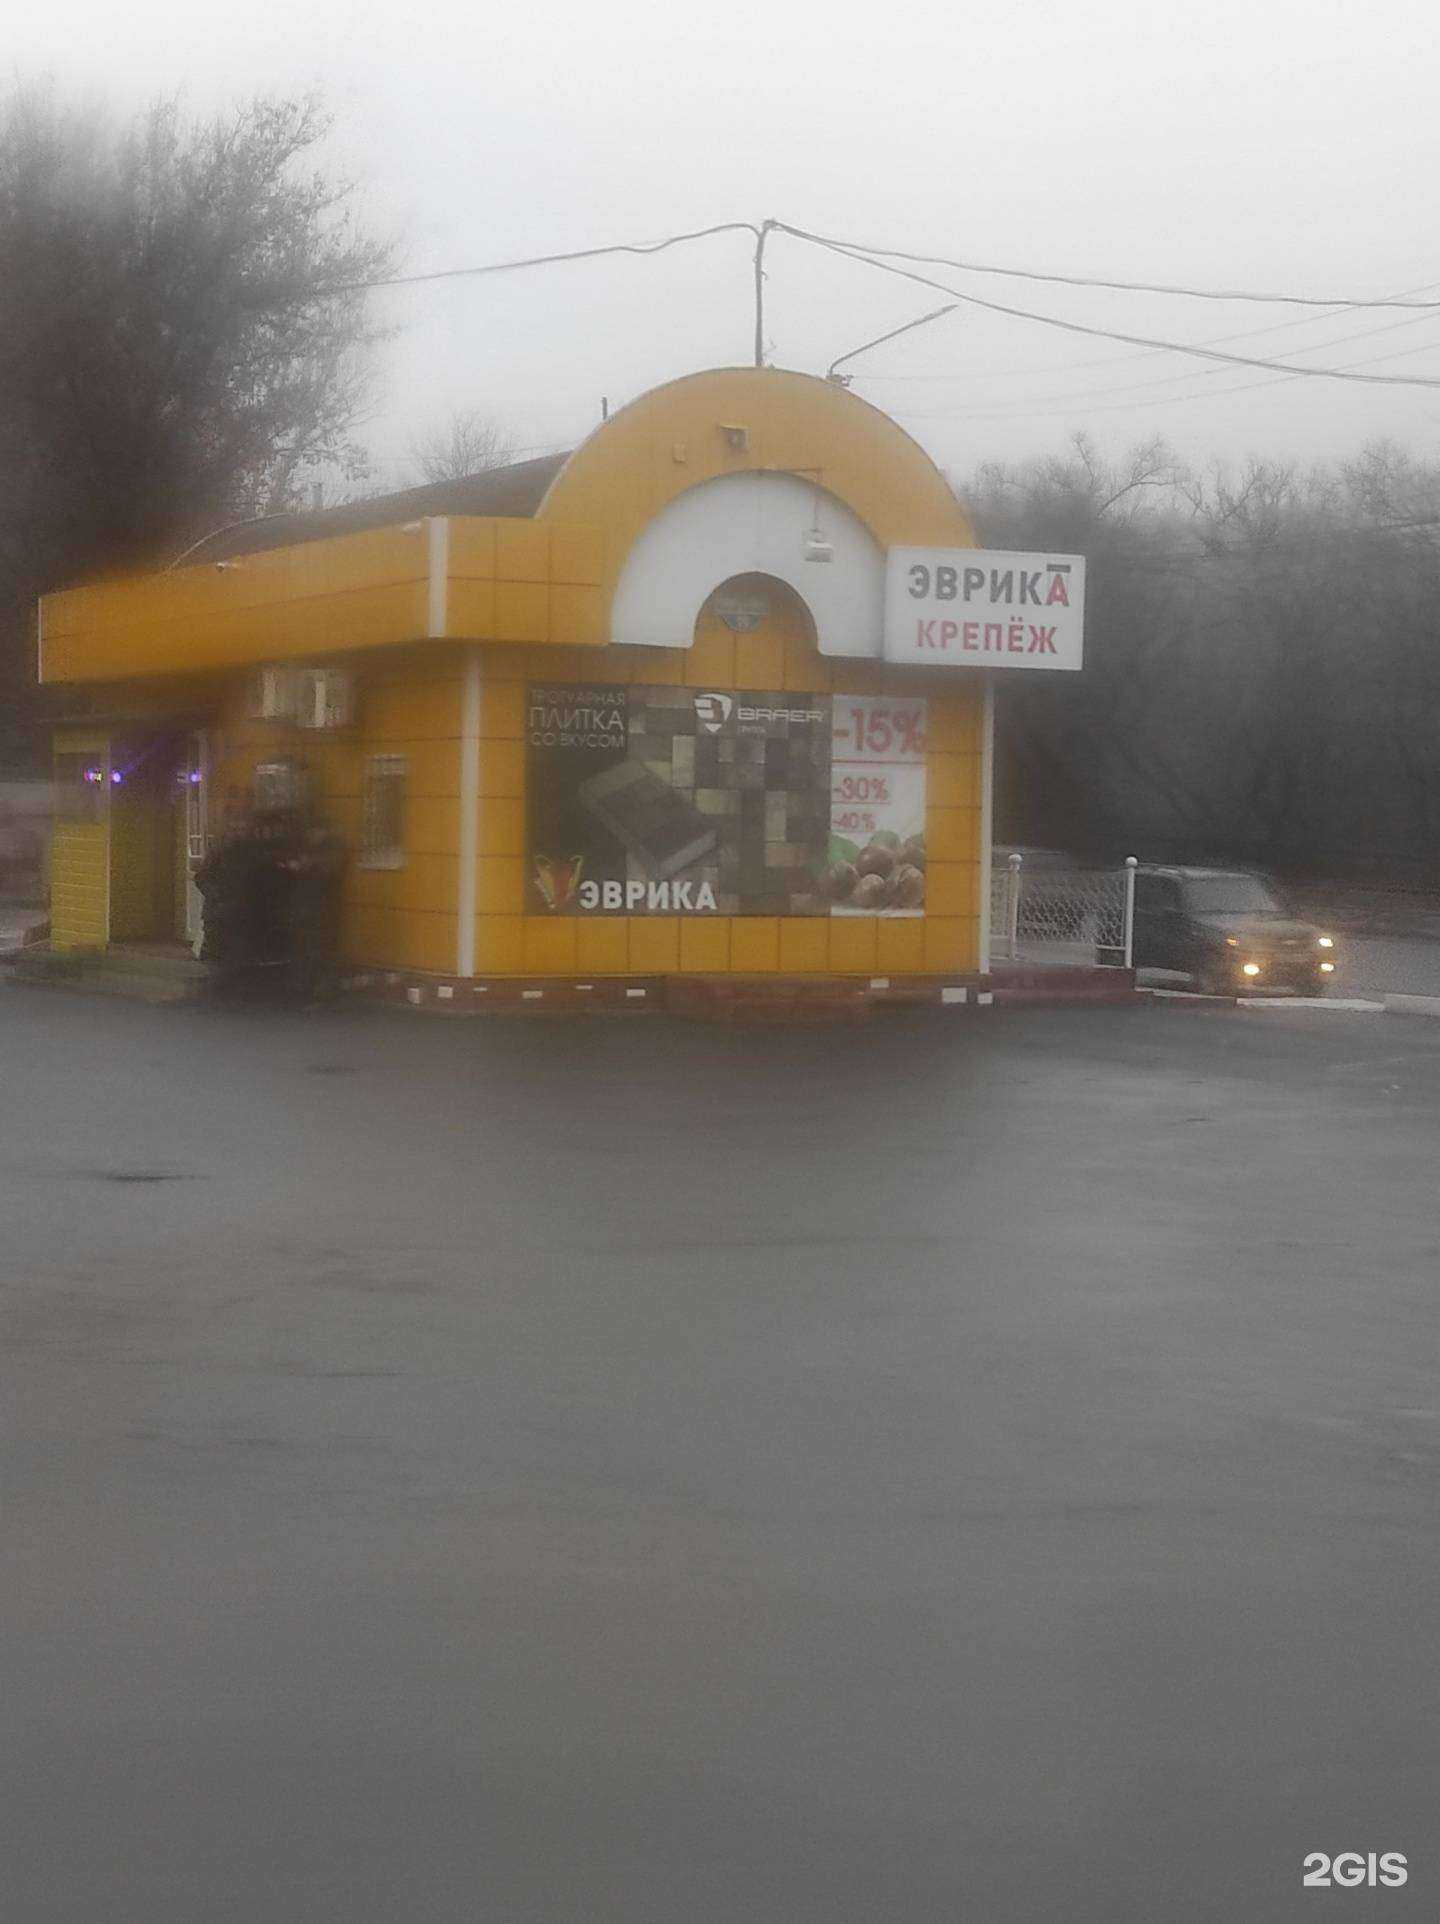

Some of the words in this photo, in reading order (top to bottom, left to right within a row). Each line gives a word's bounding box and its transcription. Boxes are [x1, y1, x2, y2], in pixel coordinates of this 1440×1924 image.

[908, 564, 1072, 607] ЭВРИКА
[916, 616, 1059, 655] КРЕПЁЖ
[530, 706, 624, 730] ПЛИТКА
[832, 708, 928, 754] -15%
[532, 732, 556, 747] СО
[560, 733, 625, 749] ВКУСОМ
[833, 777, 888, 801] -30%
[832, 811, 876, 832] -40%
[579, 880, 718, 910] ЭВРИКА
